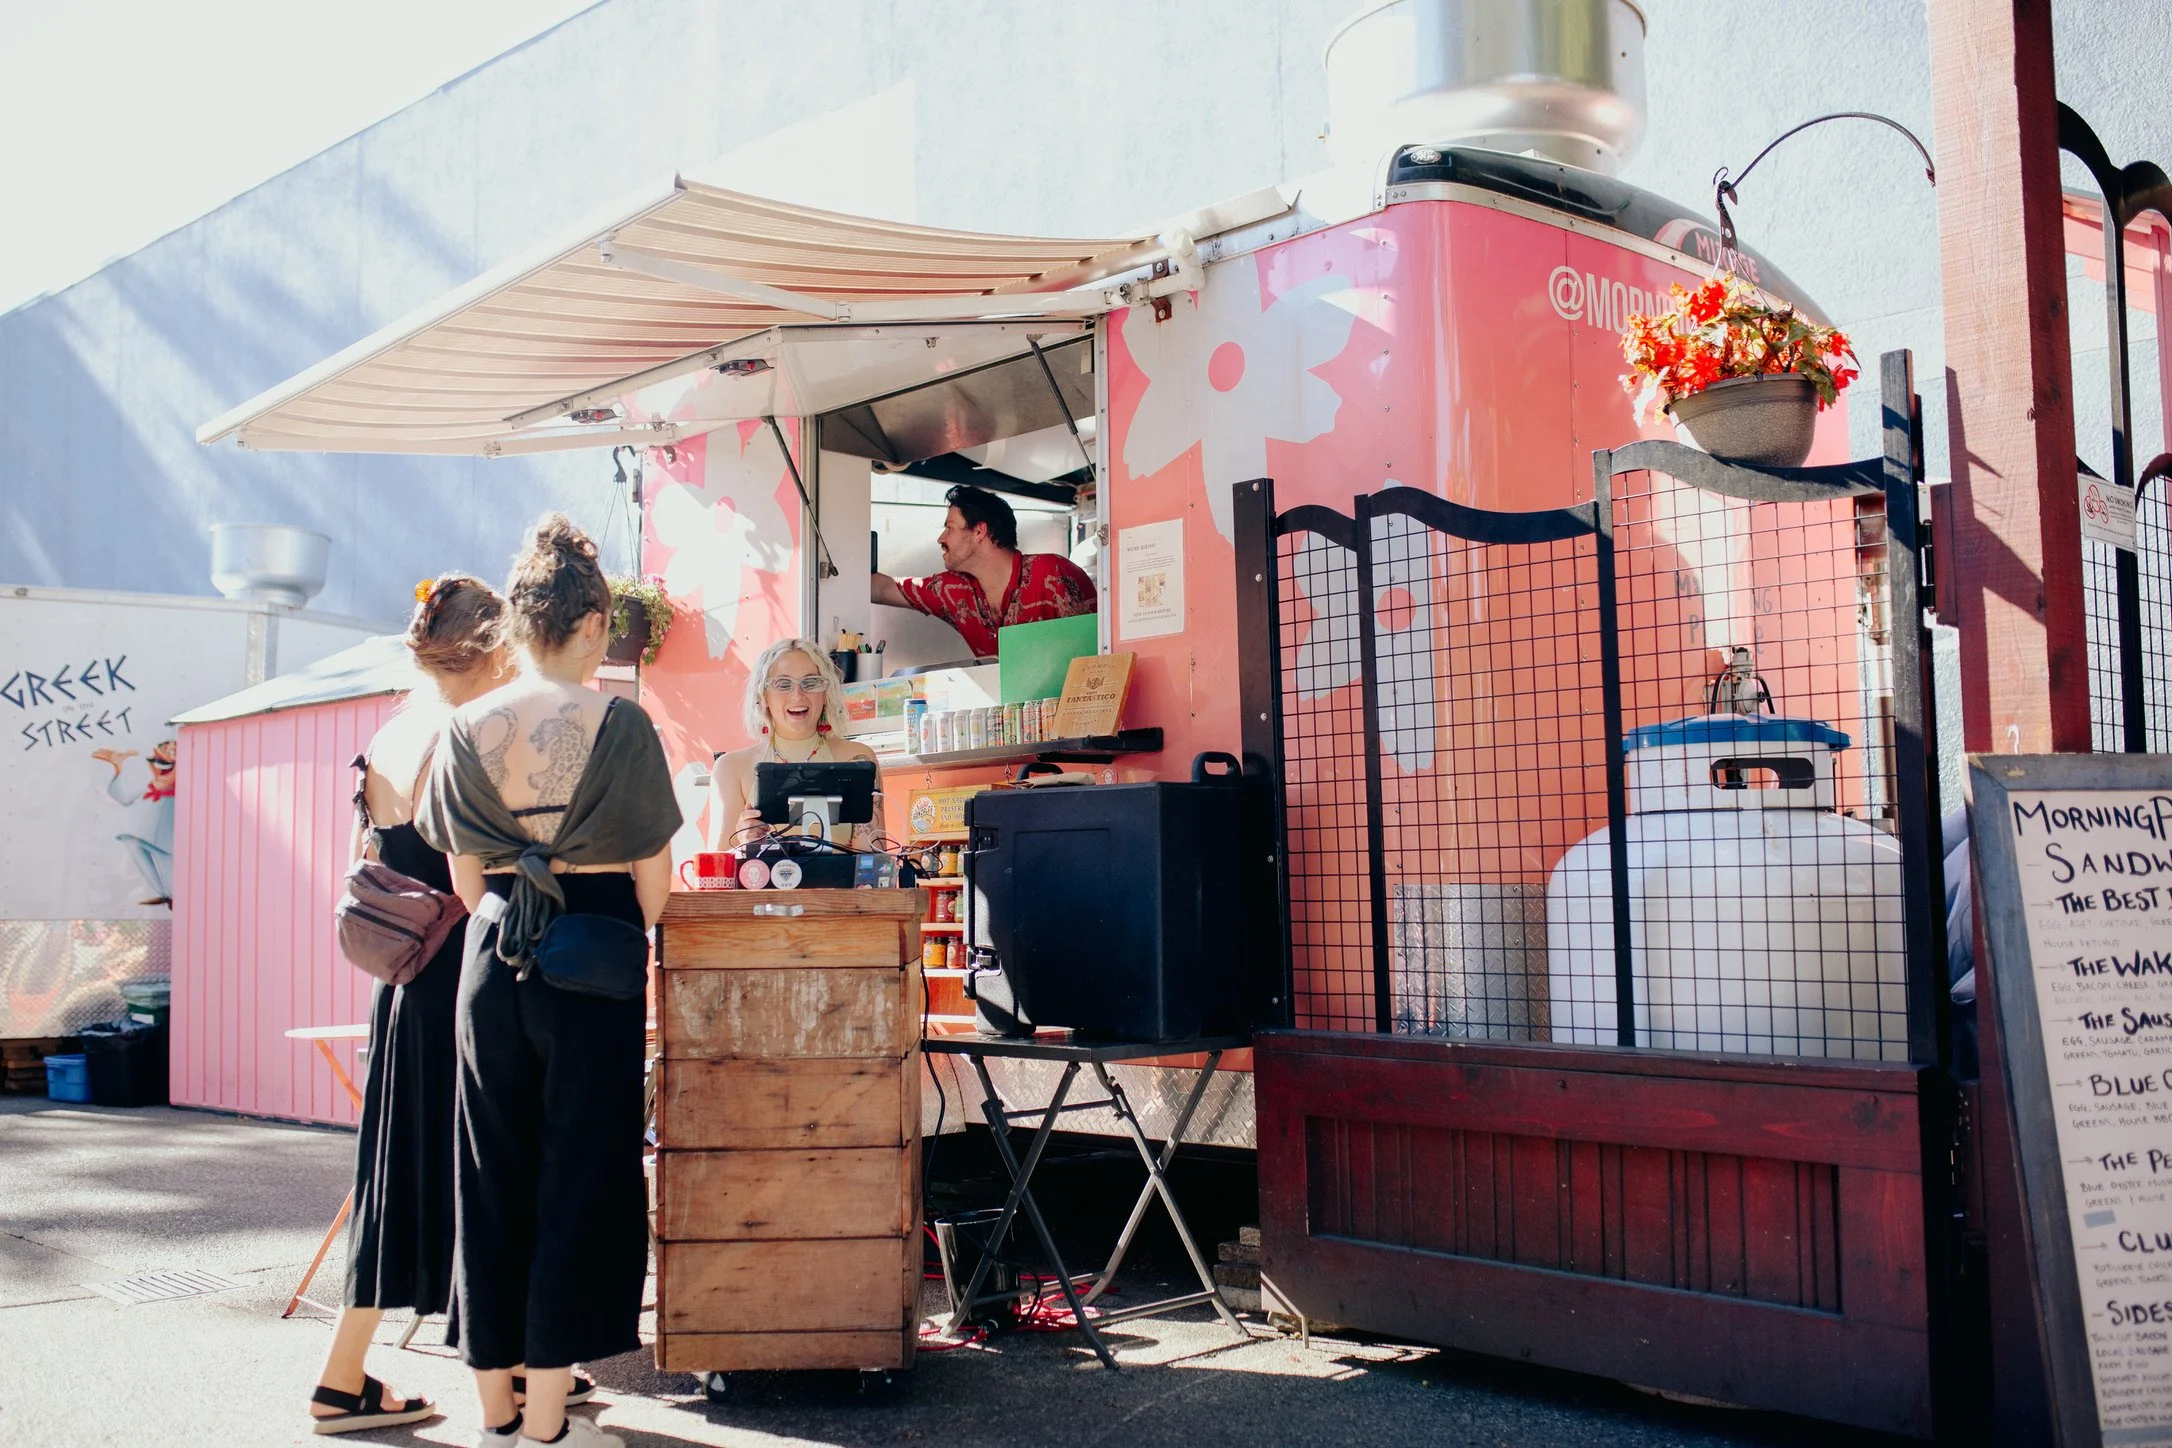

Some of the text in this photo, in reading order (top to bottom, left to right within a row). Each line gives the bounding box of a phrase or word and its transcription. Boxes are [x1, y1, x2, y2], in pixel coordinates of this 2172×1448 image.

[0, 655, 136, 709] GREEK
[1067, 693, 1116, 703] FANTASTICO
[21, 707, 132, 751] STREET
[2046, 842, 2172, 883] SANDW
[2055, 892, 2097, 914] THE
[2102, 887, 2160, 912] BEST
[2067, 950, 2172, 977] THE WAK
[2078, 1007, 2172, 1035] THE SAUS
[2088, 1074, 2159, 1096] BLUE
[2098, 1153, 2138, 1171] THE
[2107, 1300, 2172, 1326] SIDES
